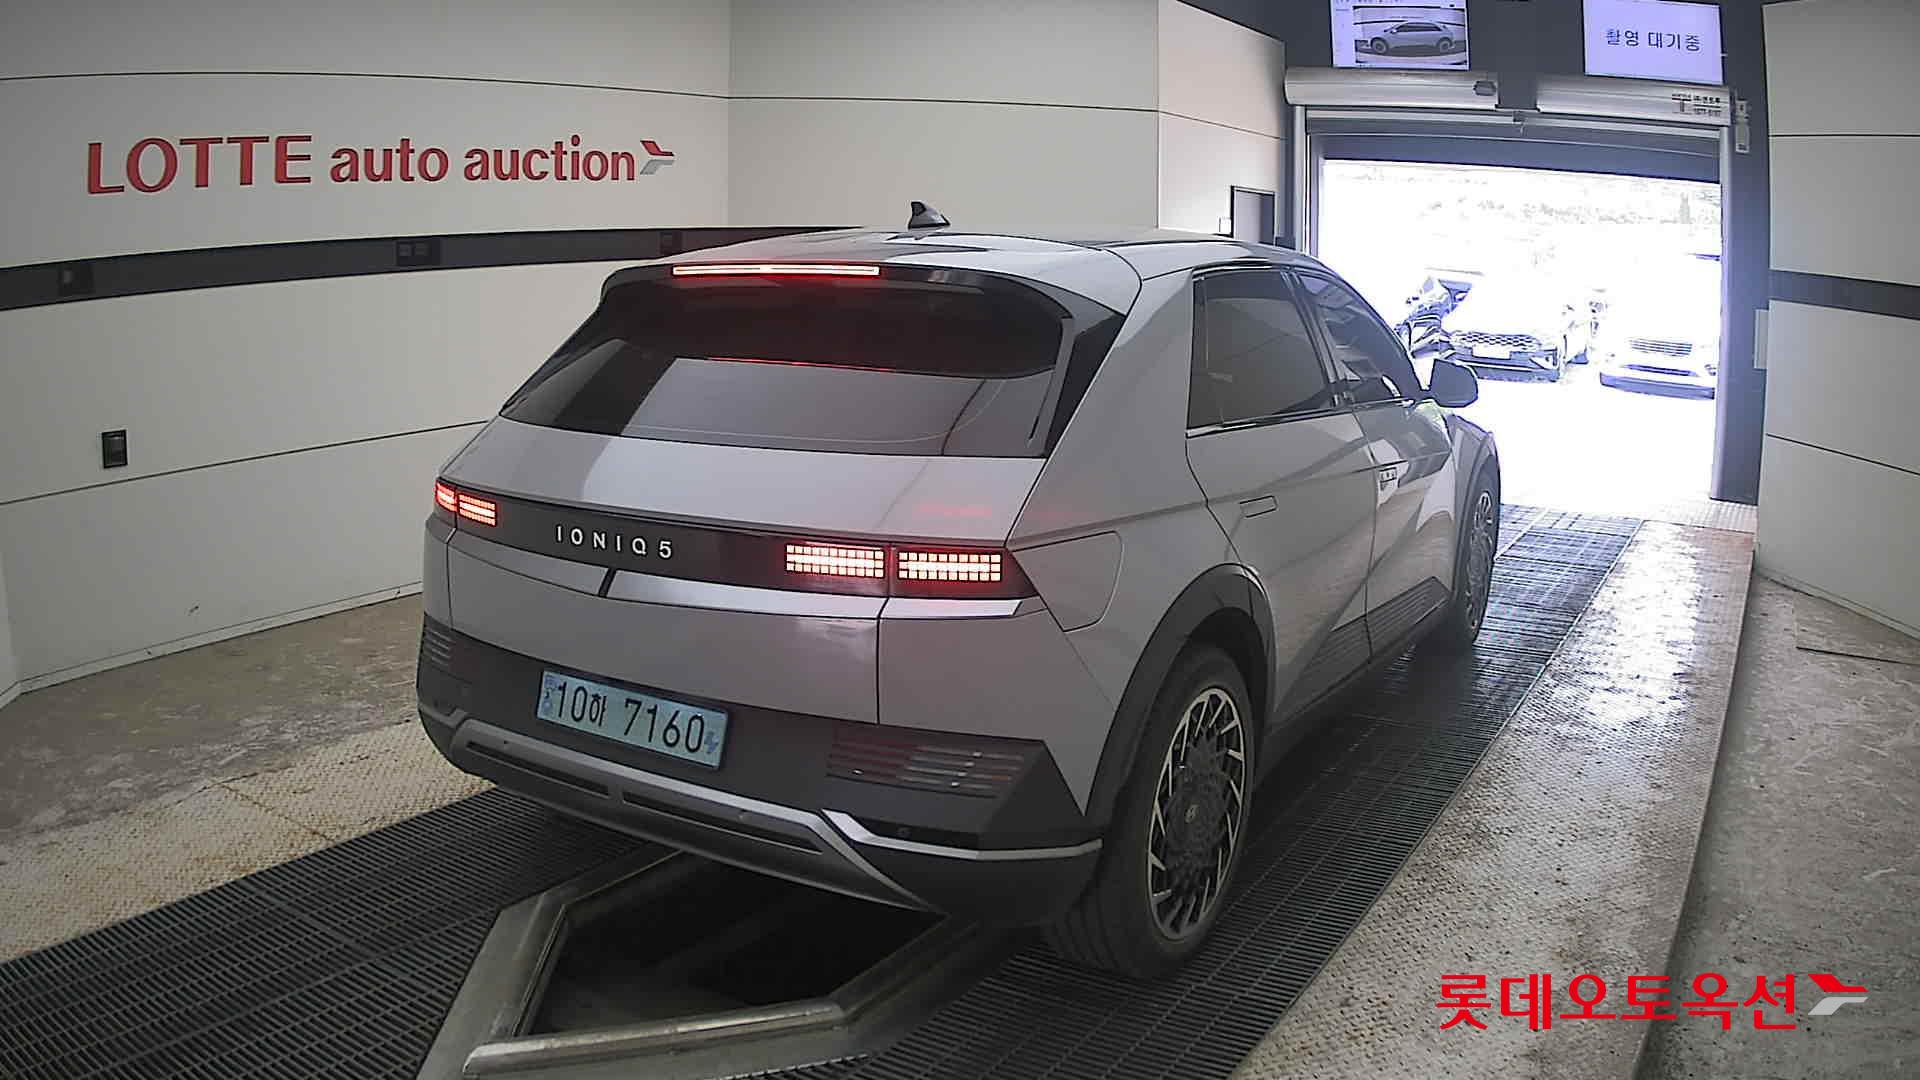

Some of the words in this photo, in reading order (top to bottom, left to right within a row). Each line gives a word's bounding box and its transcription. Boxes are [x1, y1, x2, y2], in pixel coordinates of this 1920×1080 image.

[1606, 28, 1639, 47] 촬영
[87, 135, 312, 194] LOTTE
[329, 137, 449, 183] auto
[463, 134, 636, 182] auction
[557, 525, 646, 555] IONIQ
[658, 540, 672, 559] 5
[557, 681, 607, 727] 10하
[623, 697, 705, 753] 7160
